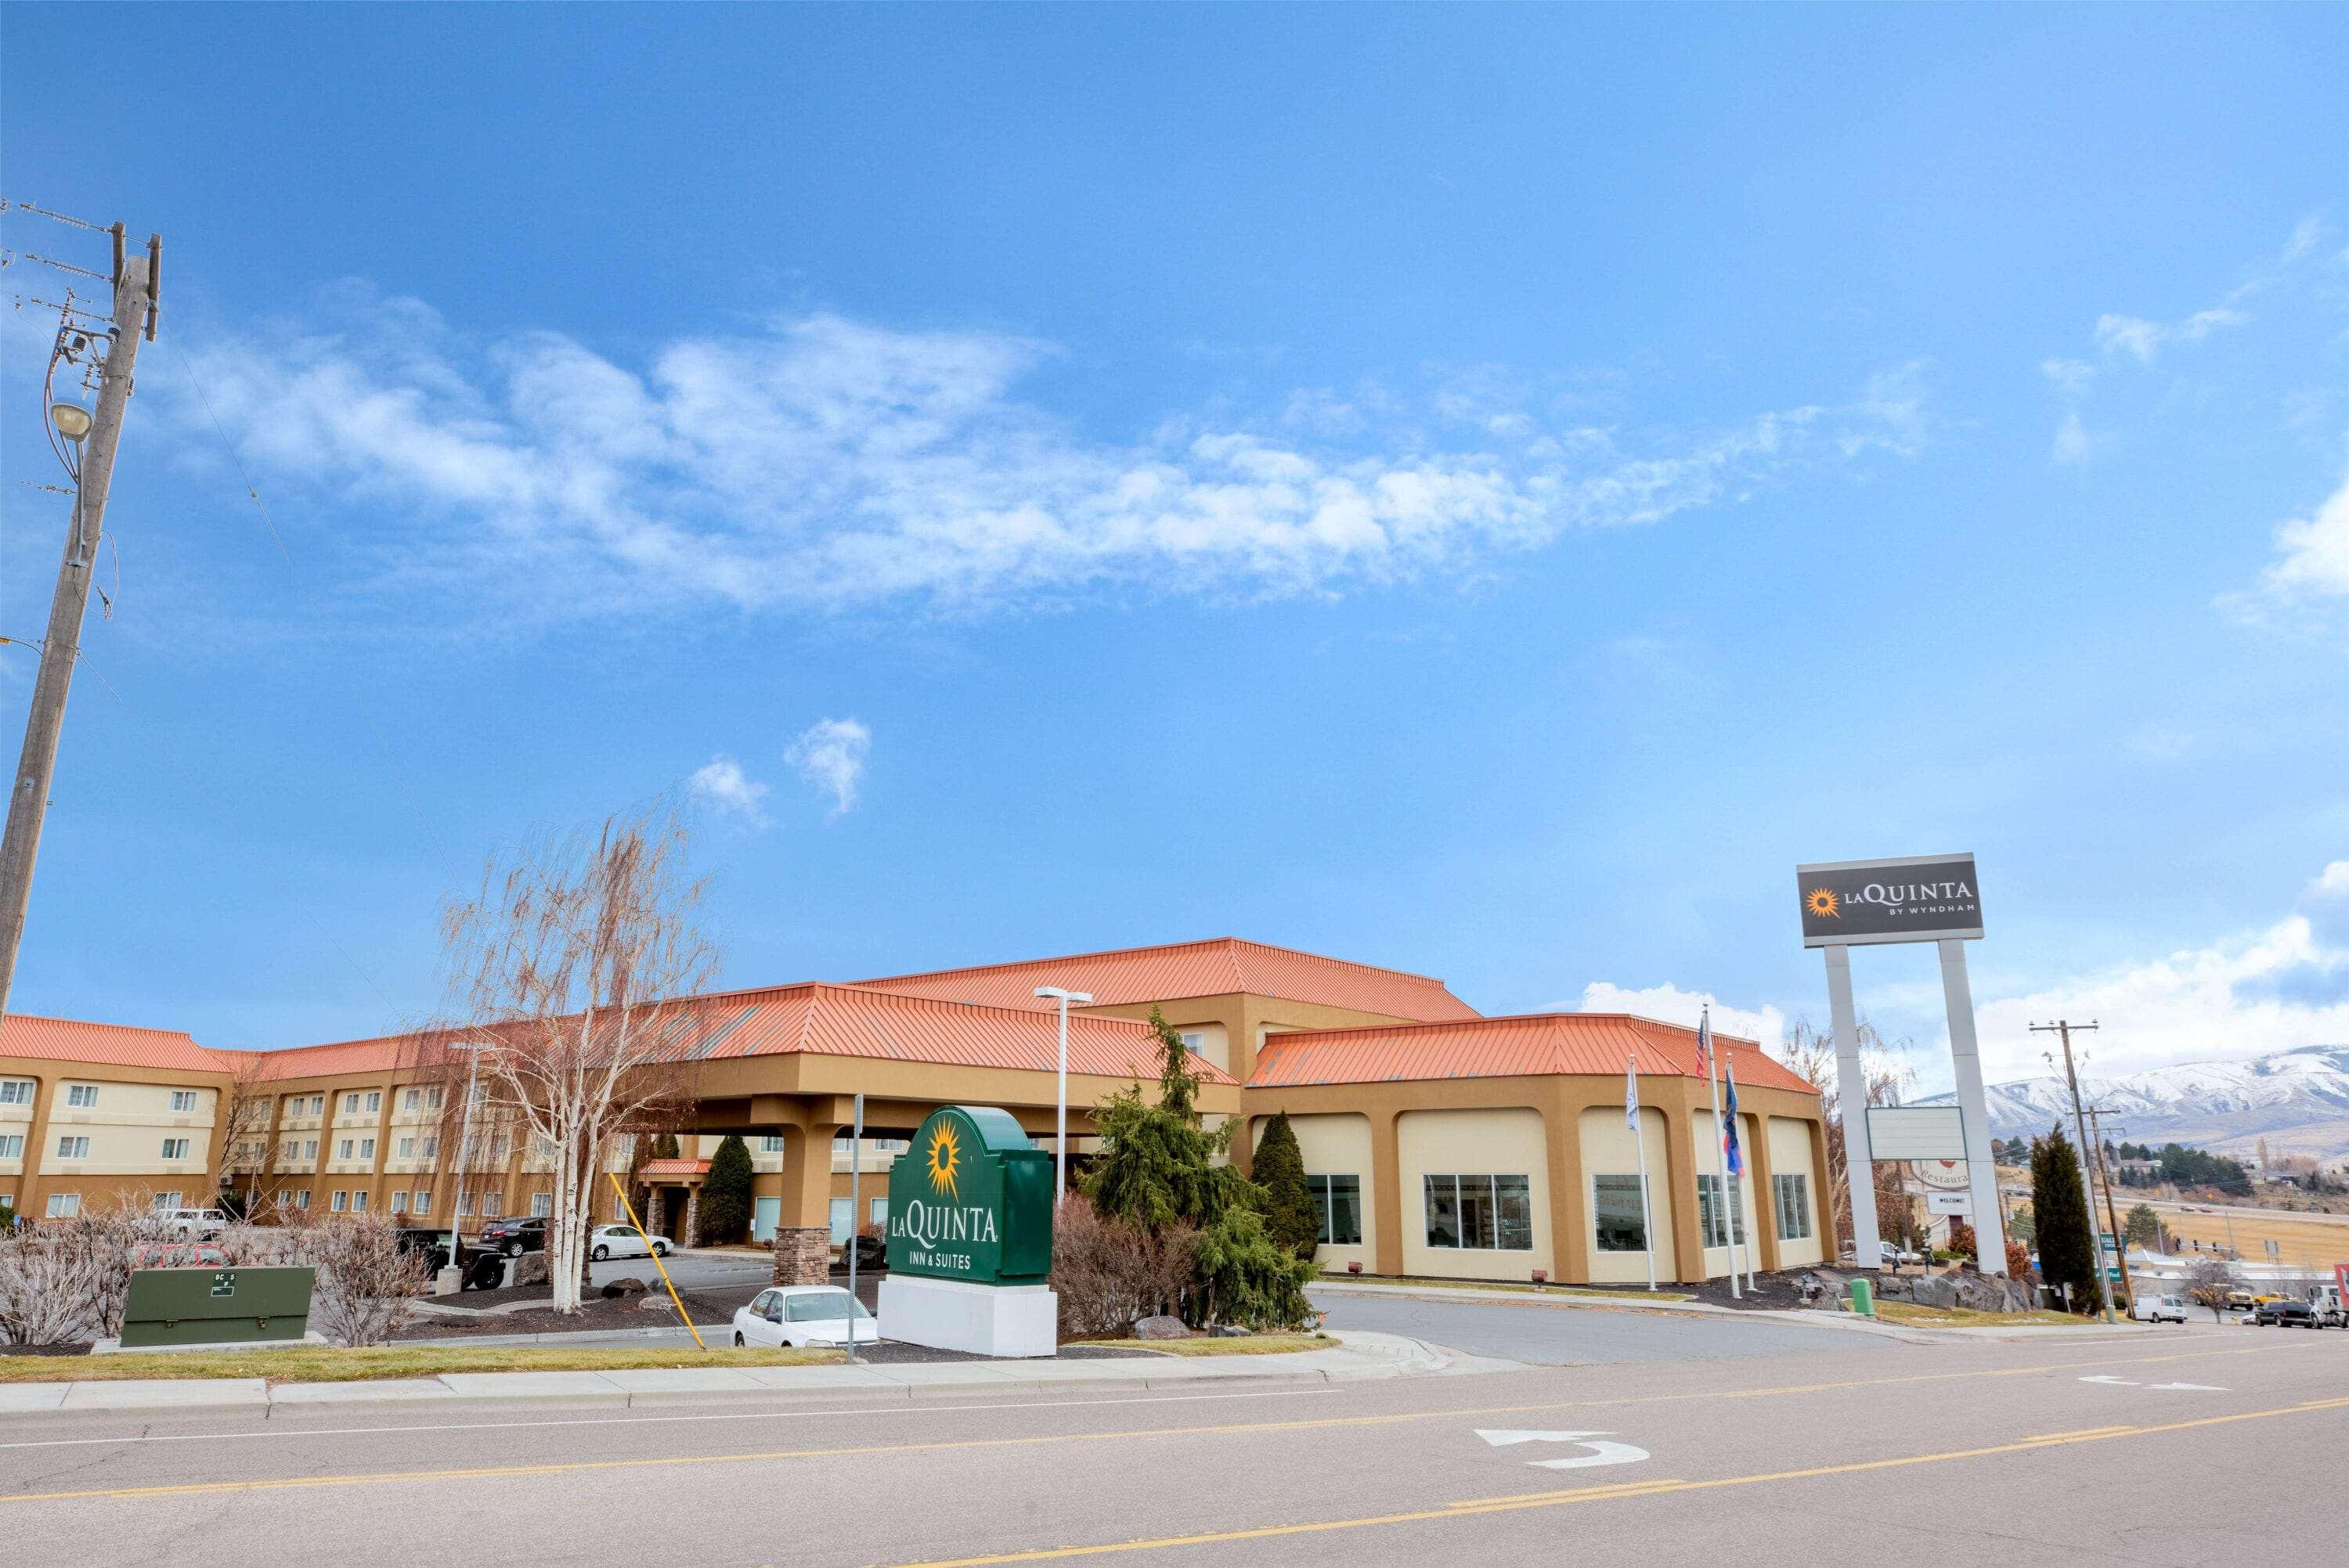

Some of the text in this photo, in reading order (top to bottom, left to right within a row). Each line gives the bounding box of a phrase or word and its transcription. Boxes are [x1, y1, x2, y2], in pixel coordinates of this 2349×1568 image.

[1844, 881, 1973, 907] LA QUINTA
[1909, 904, 1975, 914] WYNDHAM
[1921, 1170, 1968, 1184] Restaura
[891, 1199, 998, 1249] LA QUINTA
[910, 1251, 970, 1270] INN & SUITES
